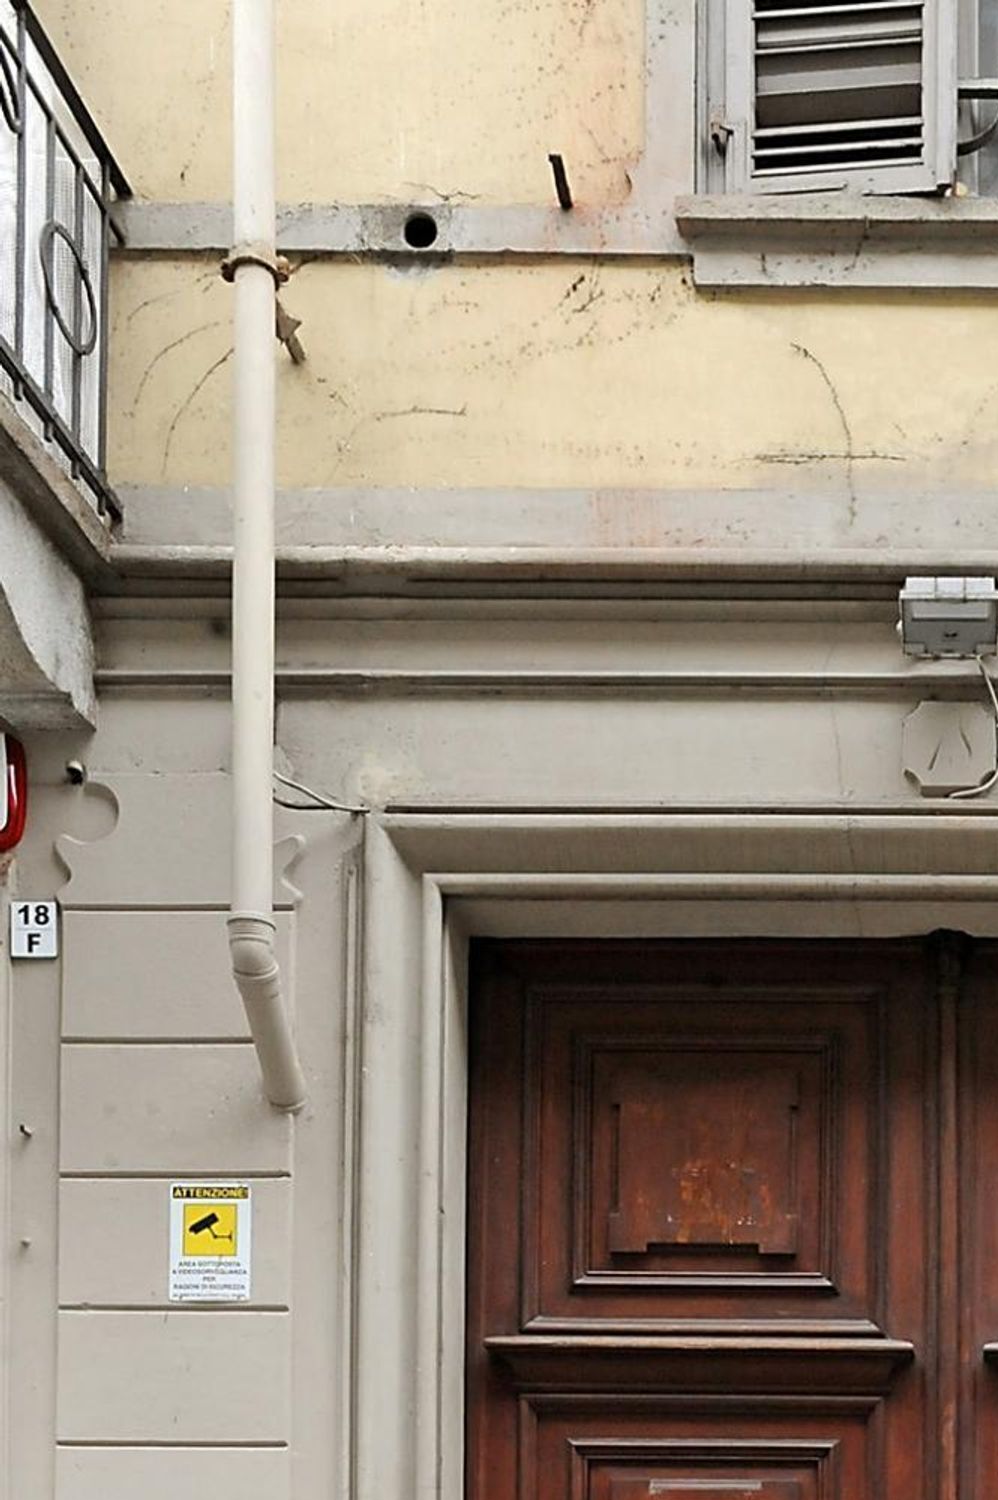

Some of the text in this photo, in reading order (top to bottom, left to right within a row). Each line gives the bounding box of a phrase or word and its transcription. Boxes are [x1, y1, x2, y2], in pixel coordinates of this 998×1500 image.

[17, 904, 50, 926] 18
[26, 933, 42, 953] F
[173, 1187, 248, 1198] ATTENZIONE
